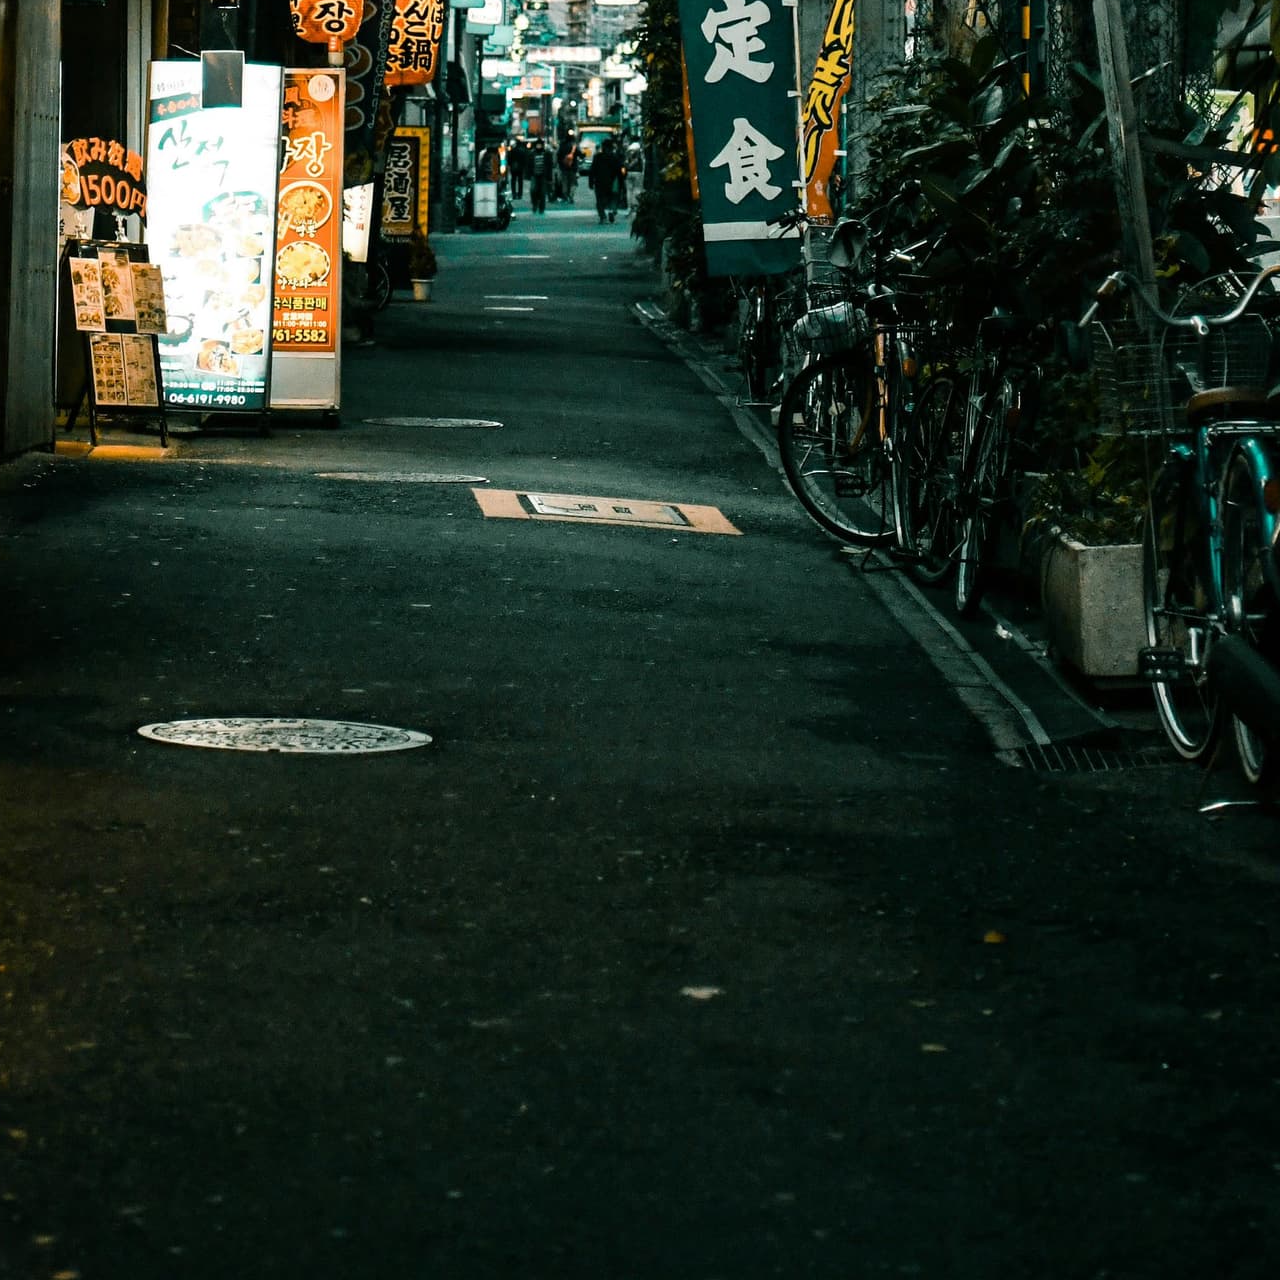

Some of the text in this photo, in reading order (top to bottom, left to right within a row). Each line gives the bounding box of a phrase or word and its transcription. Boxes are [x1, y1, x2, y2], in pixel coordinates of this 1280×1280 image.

[80, 175, 148, 218] 1500円
[384, 142, 413, 223] 居酒屋
[169, 392, 246, 405] 06-6191-9980
